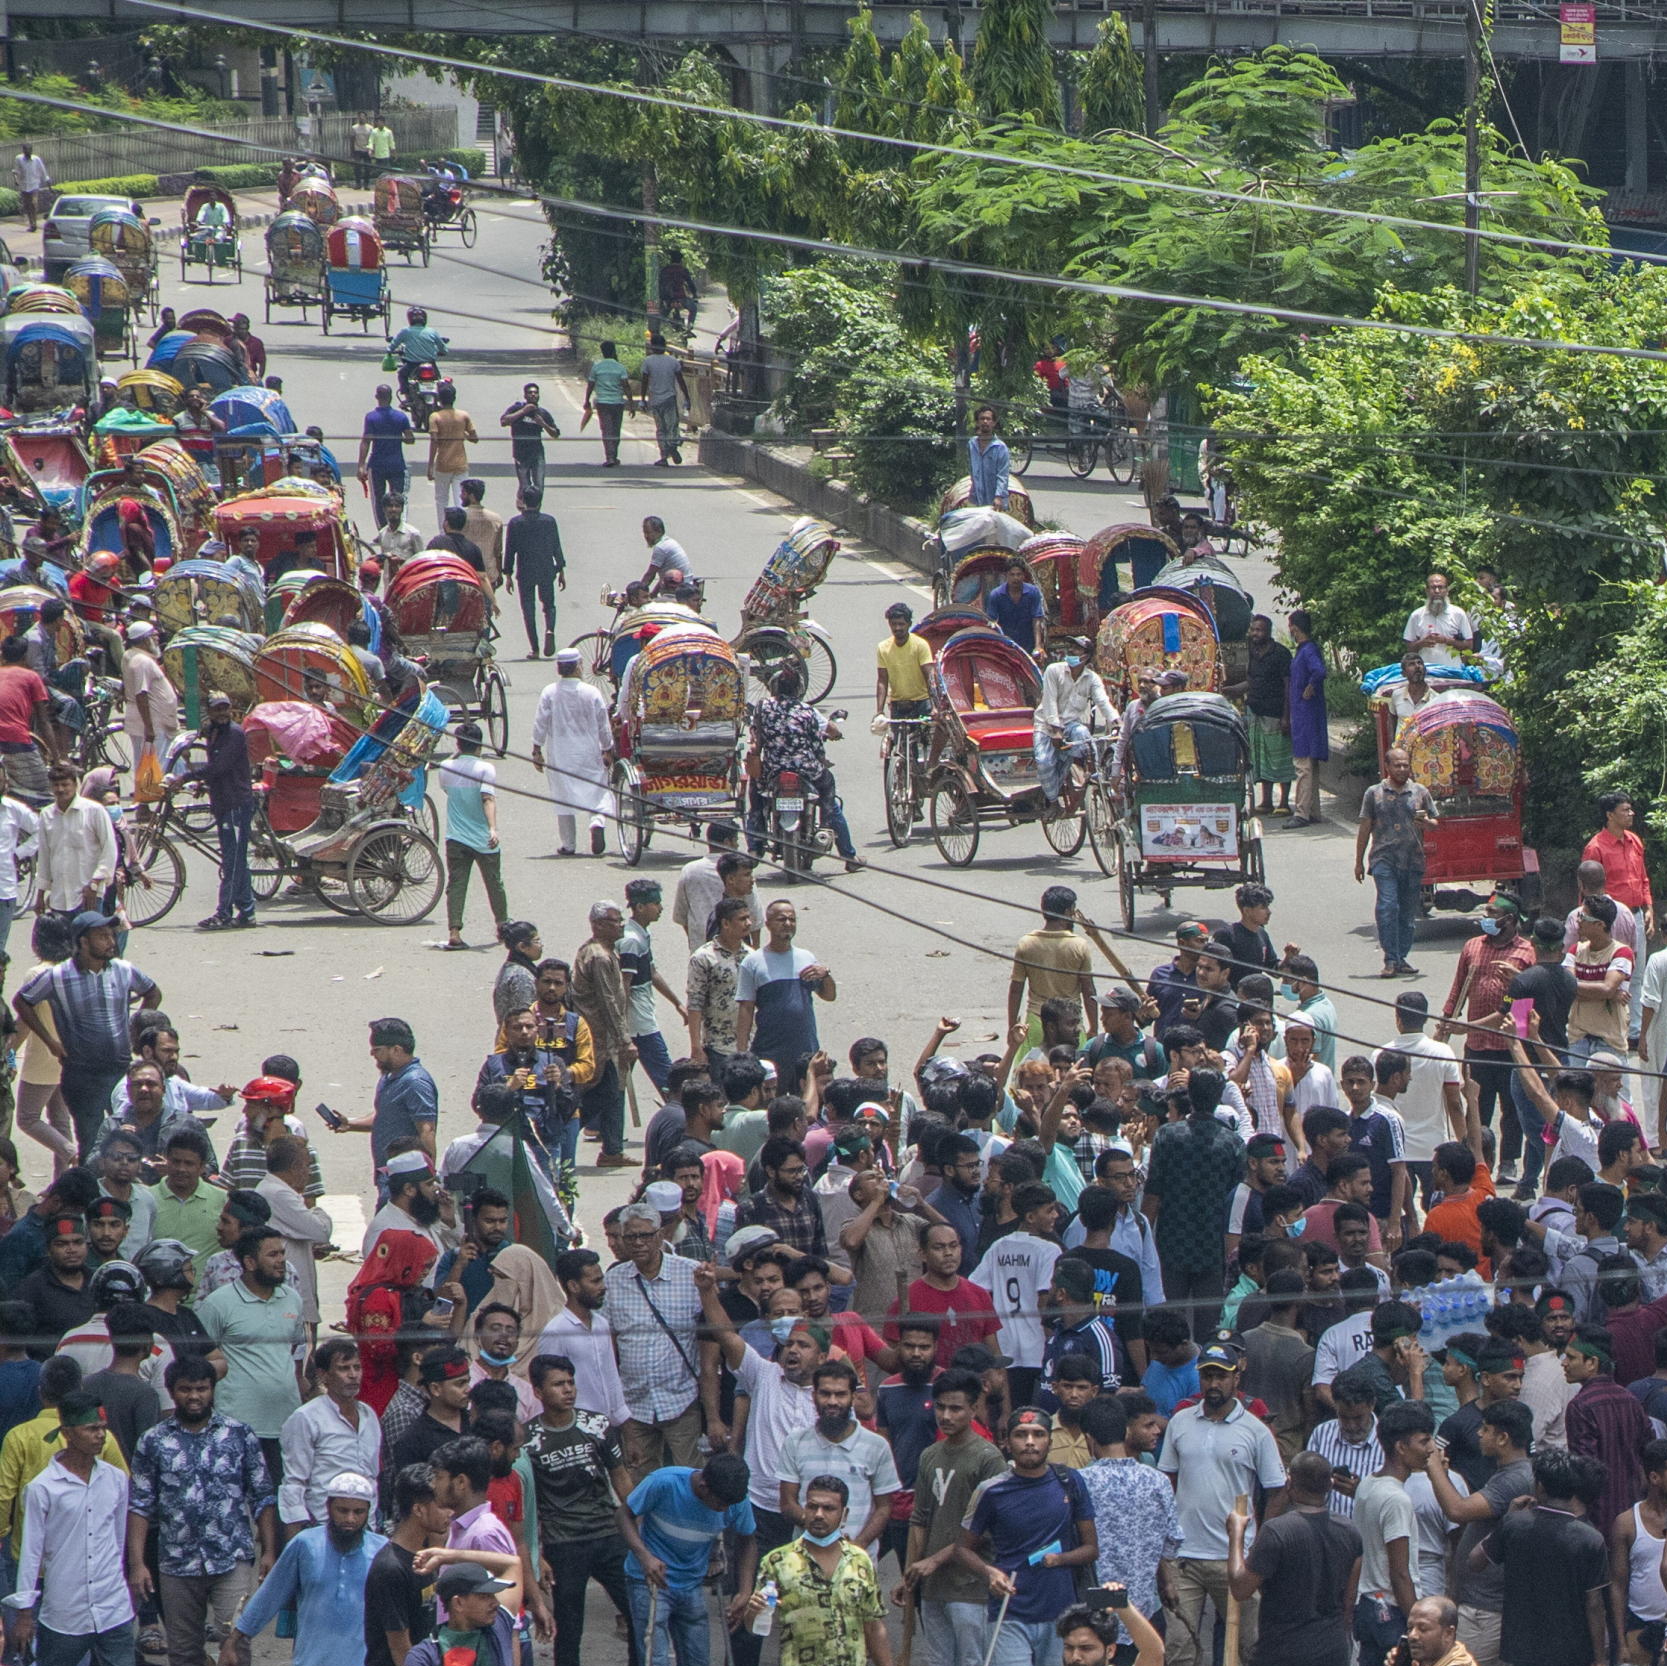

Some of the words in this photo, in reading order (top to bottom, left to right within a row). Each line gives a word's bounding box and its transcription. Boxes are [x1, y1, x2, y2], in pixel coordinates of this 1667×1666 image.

[997, 1253, 1030, 1267] MAHIM
[1007, 1277, 1021, 1315] 9
[540, 1442, 593, 1465] DEVISE
